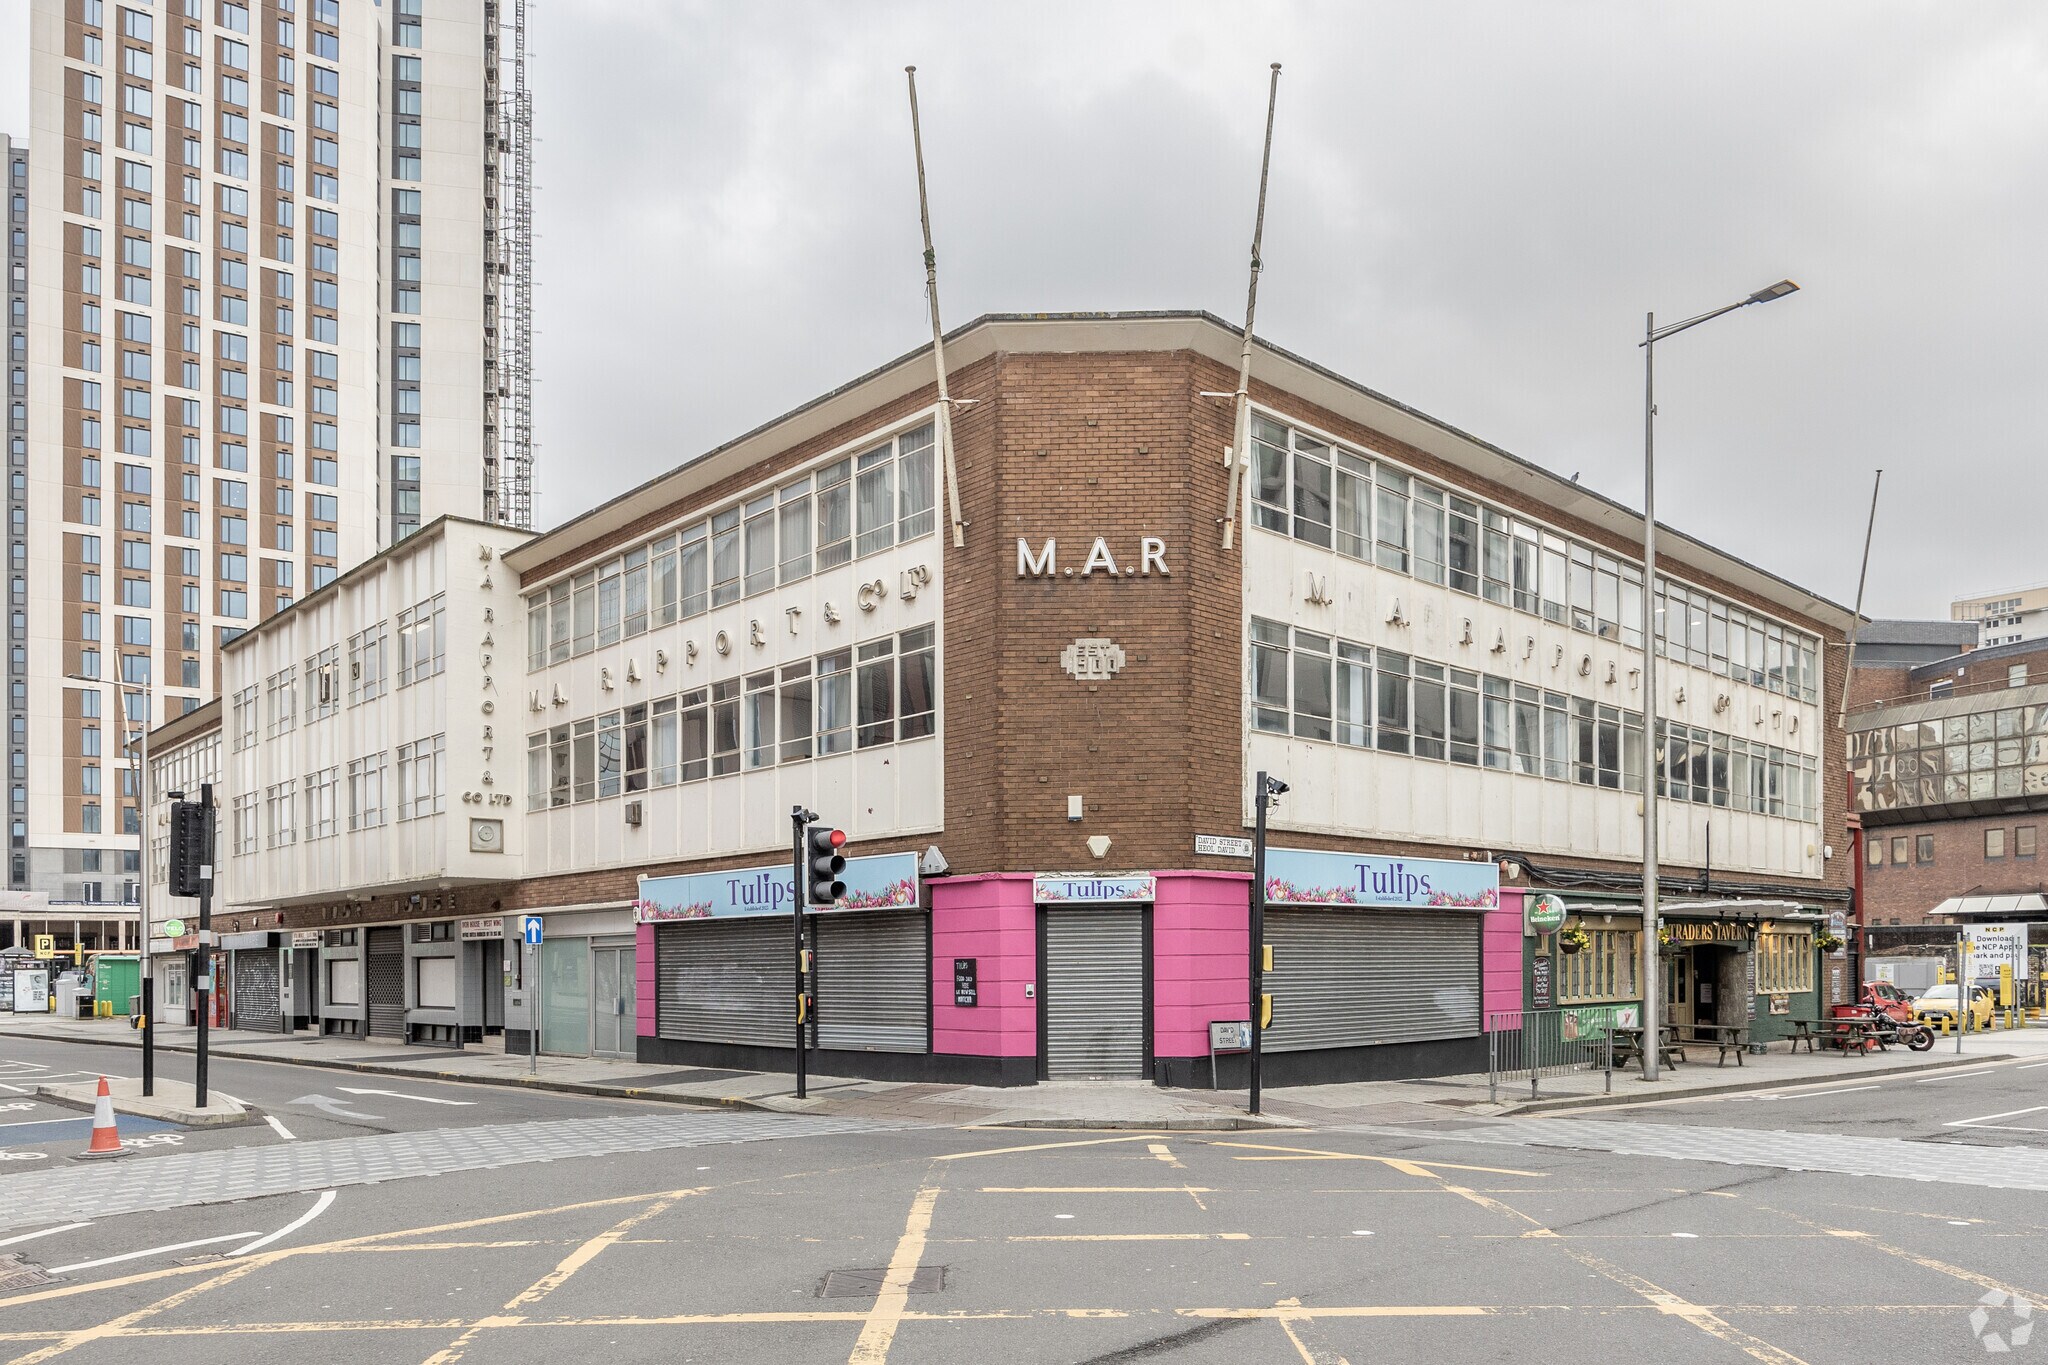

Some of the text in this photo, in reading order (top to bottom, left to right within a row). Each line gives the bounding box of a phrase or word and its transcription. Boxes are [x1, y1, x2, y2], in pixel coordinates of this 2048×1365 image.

[601, 605, 802, 692] RAPPORT
[823, 602, 841, 625] &
[480, 607, 495, 761] RAPPORT
[1458, 616, 1641, 692] RAPPORT
[1674, 685, 1687, 704] &
[1754, 703, 1799, 735] LTD
[481, 770, 494, 785] &
[488, 793, 513, 806] LTD
[1219, 839, 1242, 847] STREET
[727, 873, 794, 909] Tulips
[1063, 880, 1126, 900] Tulips
[1354, 863, 1431, 902] Tulips
[469, 920, 481, 928] HOUSE
[493, 919, 502, 927] WING
[1530, 914, 1561, 923] Heineken
[1668, 923, 1713, 940] TRADERS
[1715, 924, 1749, 940] TAVERN
[41, 939, 49, 949] P
